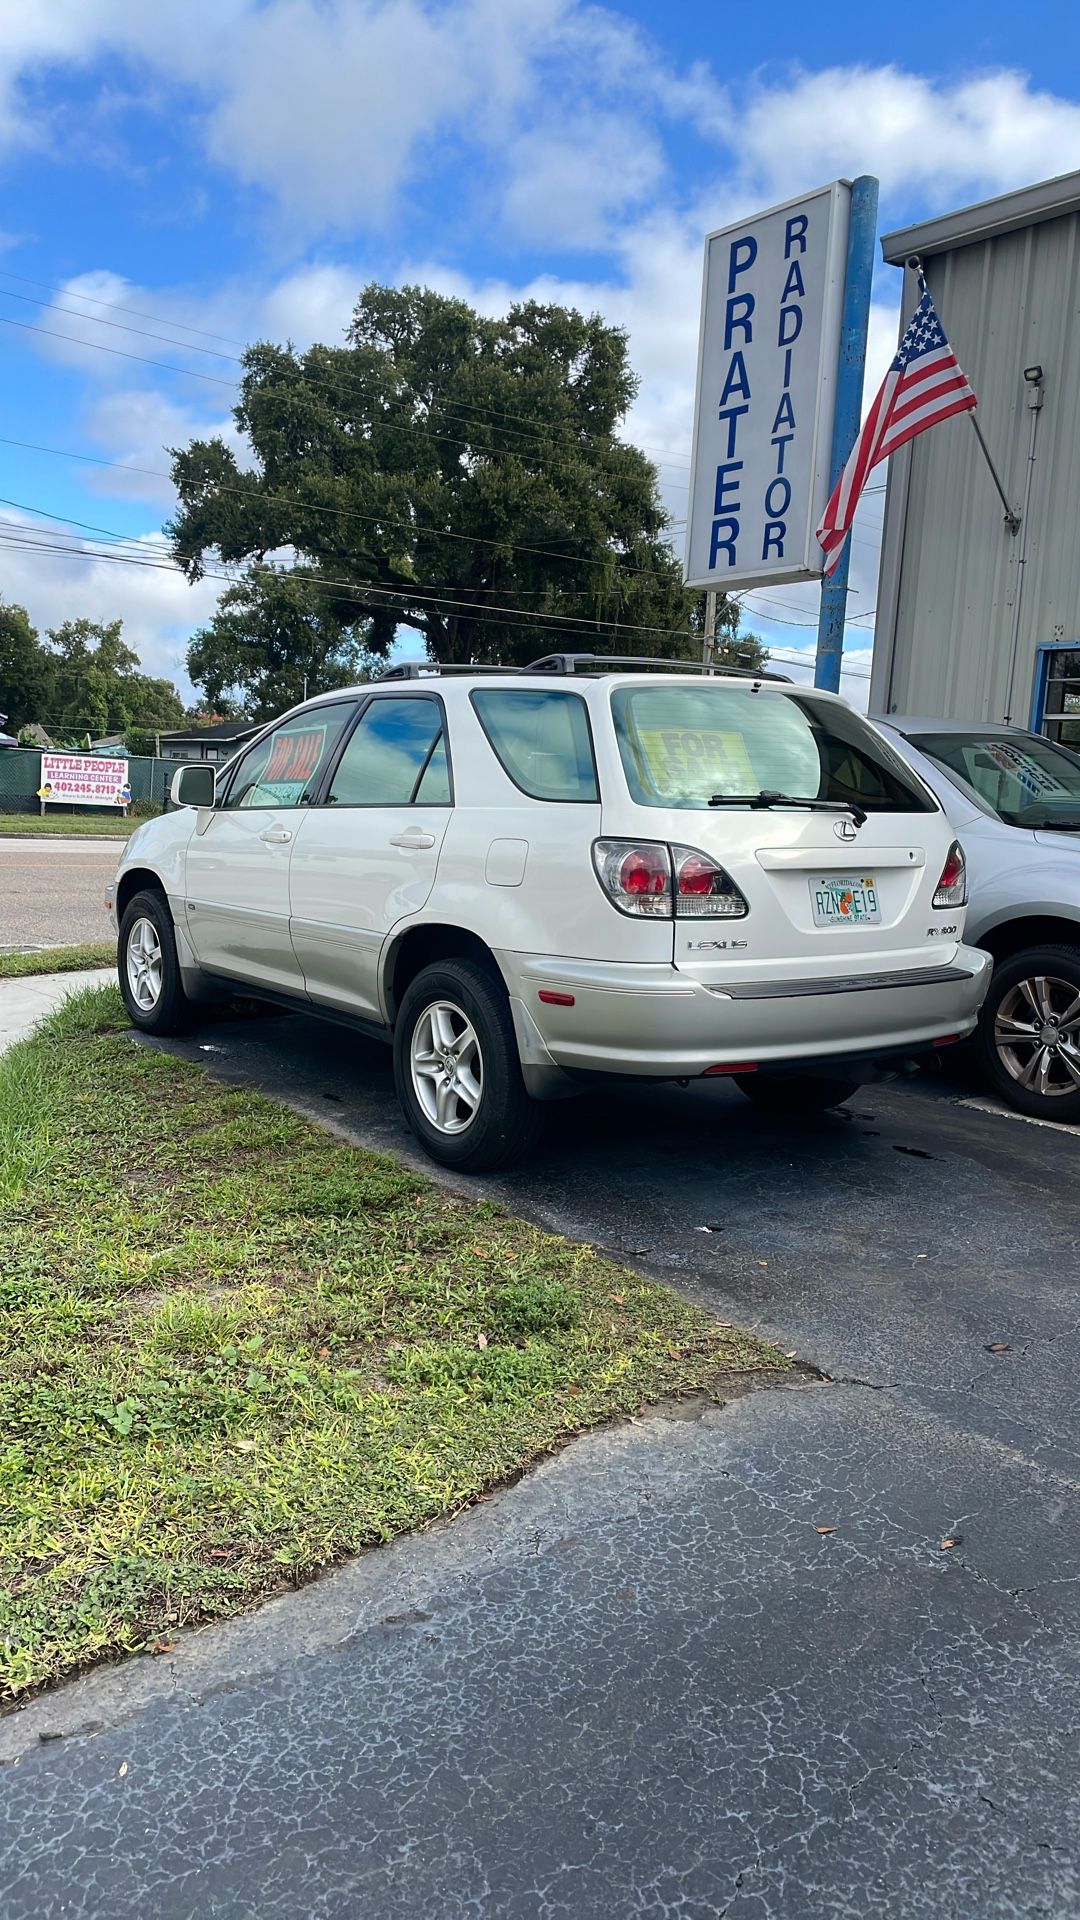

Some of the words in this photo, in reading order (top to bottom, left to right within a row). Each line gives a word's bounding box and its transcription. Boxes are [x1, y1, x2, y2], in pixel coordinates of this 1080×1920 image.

[761, 214, 809, 561] RADIATOR
[708, 235, 758, 570] PRATER
[661, 733, 728, 760] FOR
[44, 757, 82, 770] LITTLE
[84, 760, 125, 773] PEOPLE
[50, 771, 89, 781] LEARNING
[90, 775, 119, 783] CENTER
[816, 891, 840, 915] RZN
[853, 889, 877, 913] E19
[687, 940, 748, 950] LEXUS
